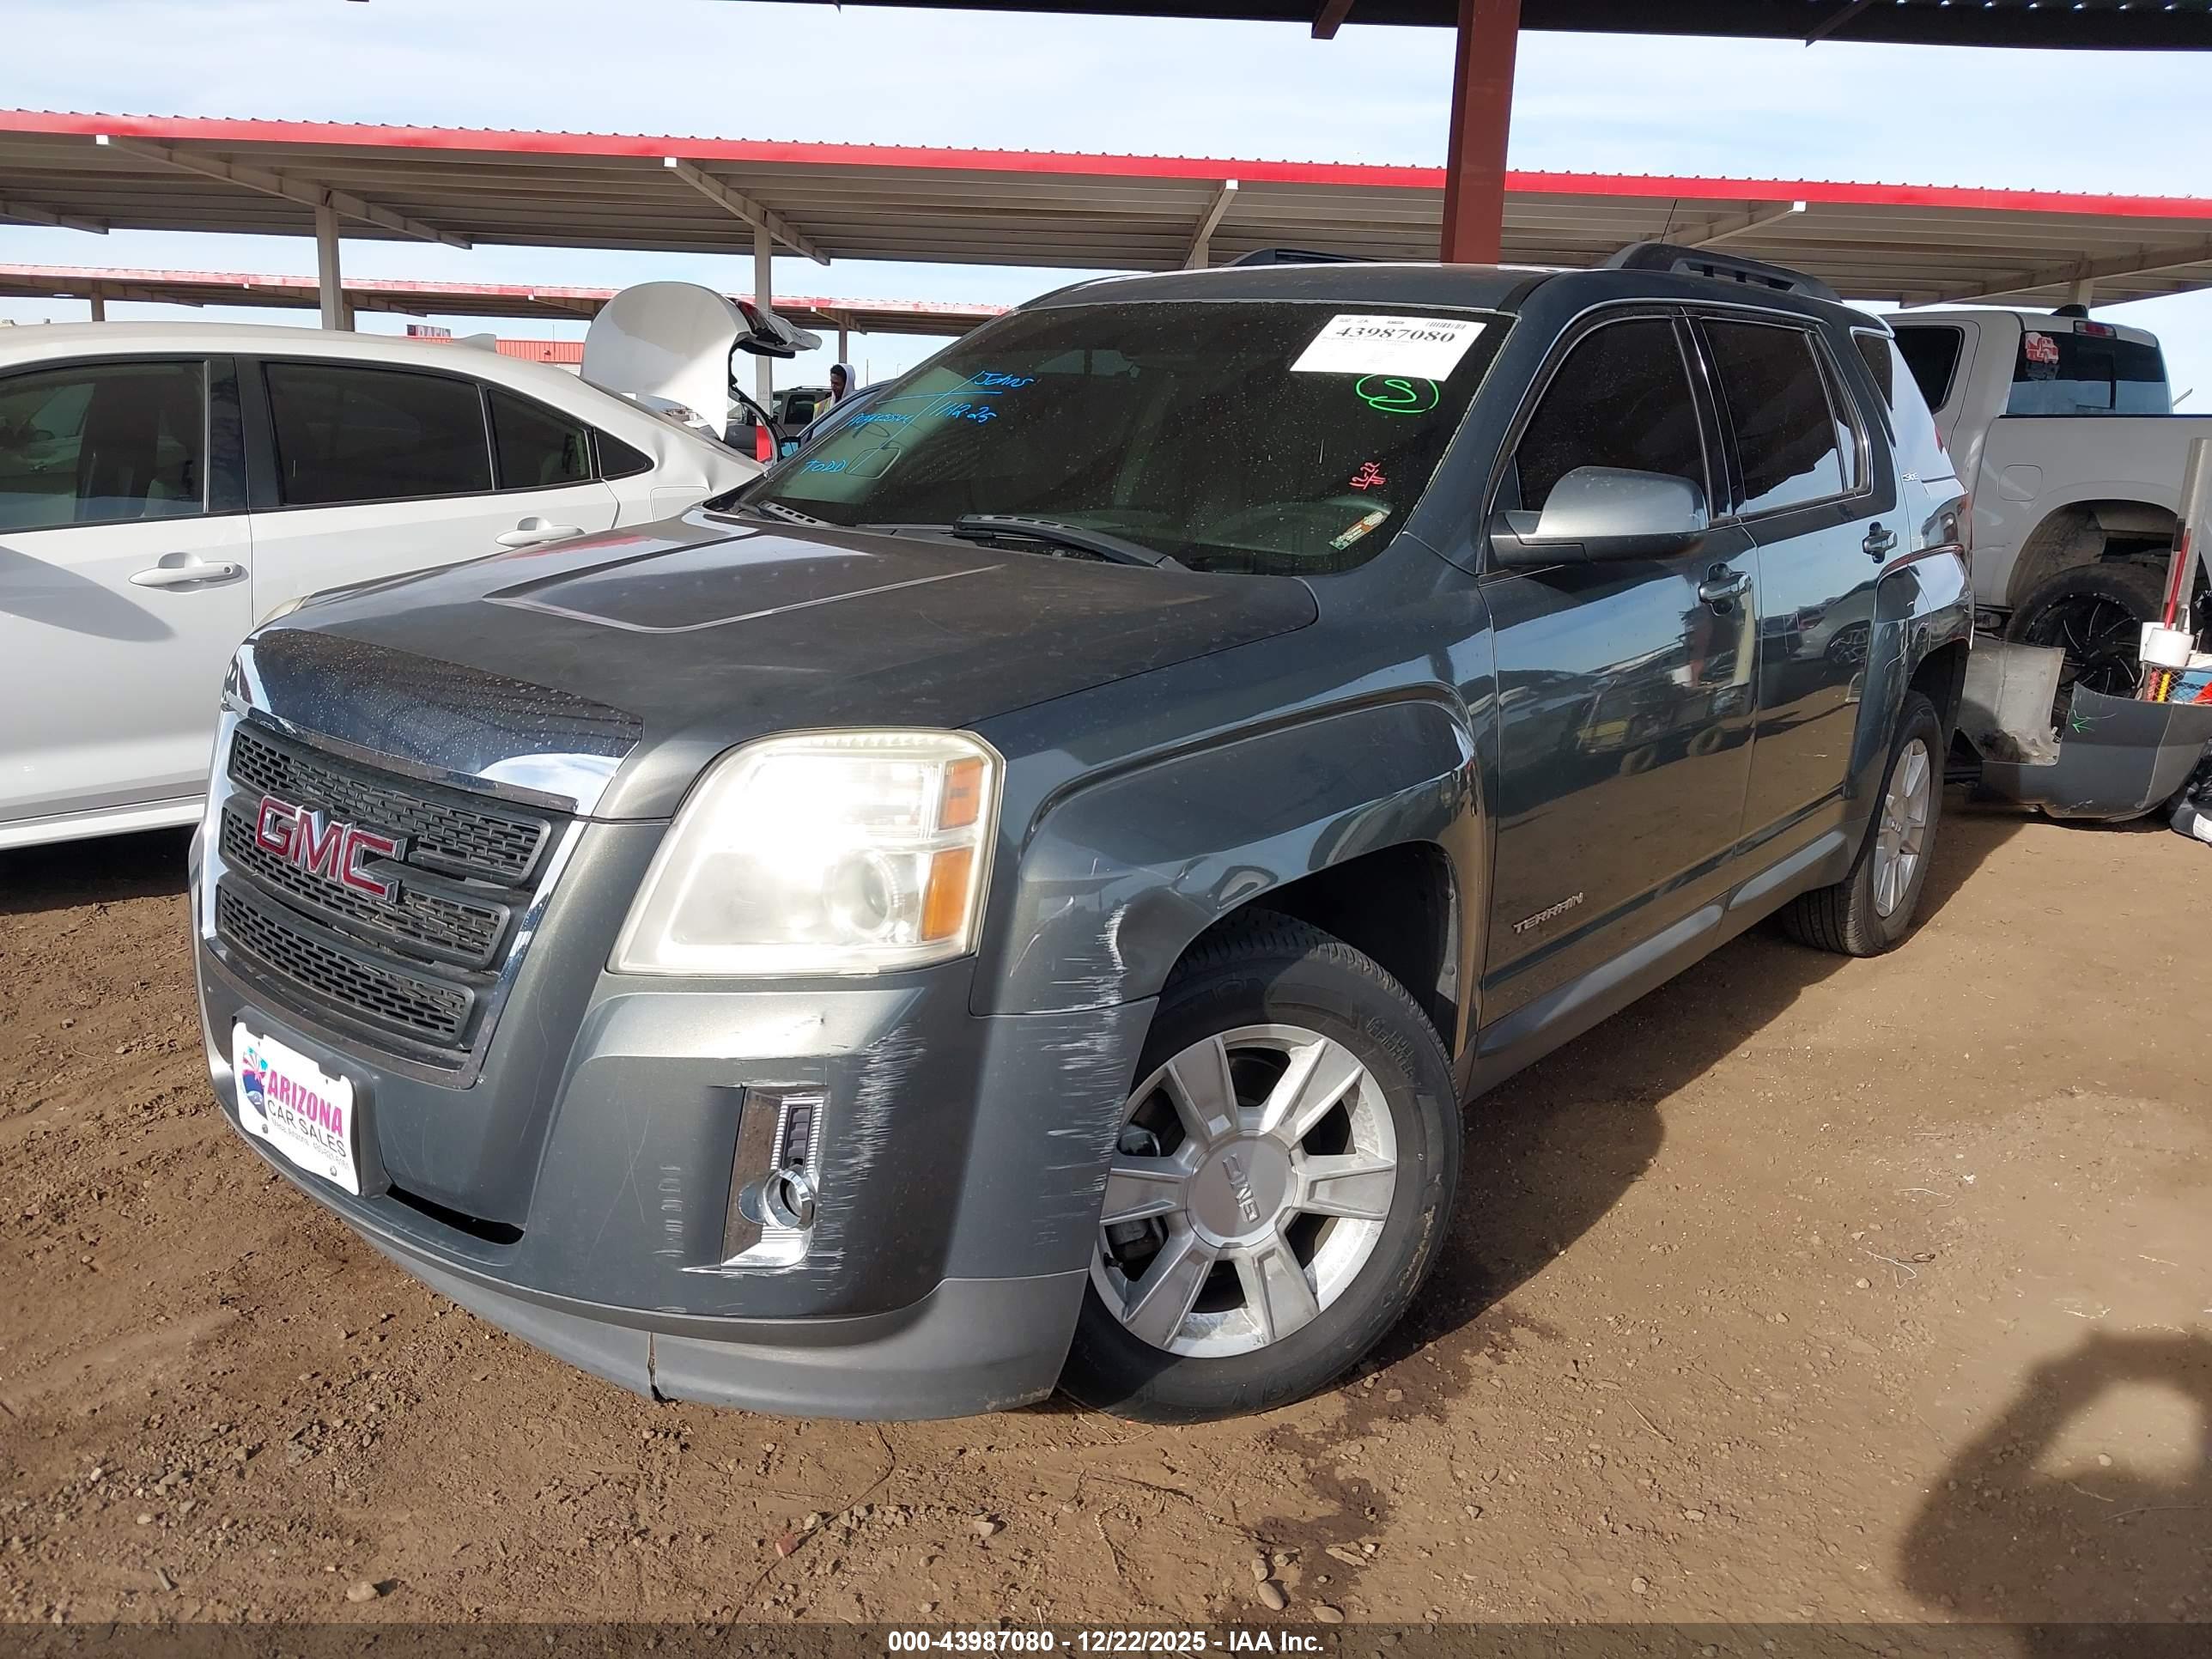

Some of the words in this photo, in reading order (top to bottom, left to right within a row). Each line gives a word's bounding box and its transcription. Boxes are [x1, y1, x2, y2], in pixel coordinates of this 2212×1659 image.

[1336, 326, 1455, 343] 43987080
[800, 459, 846, 474] TODD
[256, 795, 408, 902] GMC
[1513, 892, 1583, 934] TERRAIN
[267, 1071, 343, 1137] ARIZONA
[267, 1099, 297, 1129] CAR
[299, 1118, 346, 1158] SALES
[1222, 1153, 1261, 1224] GMC
